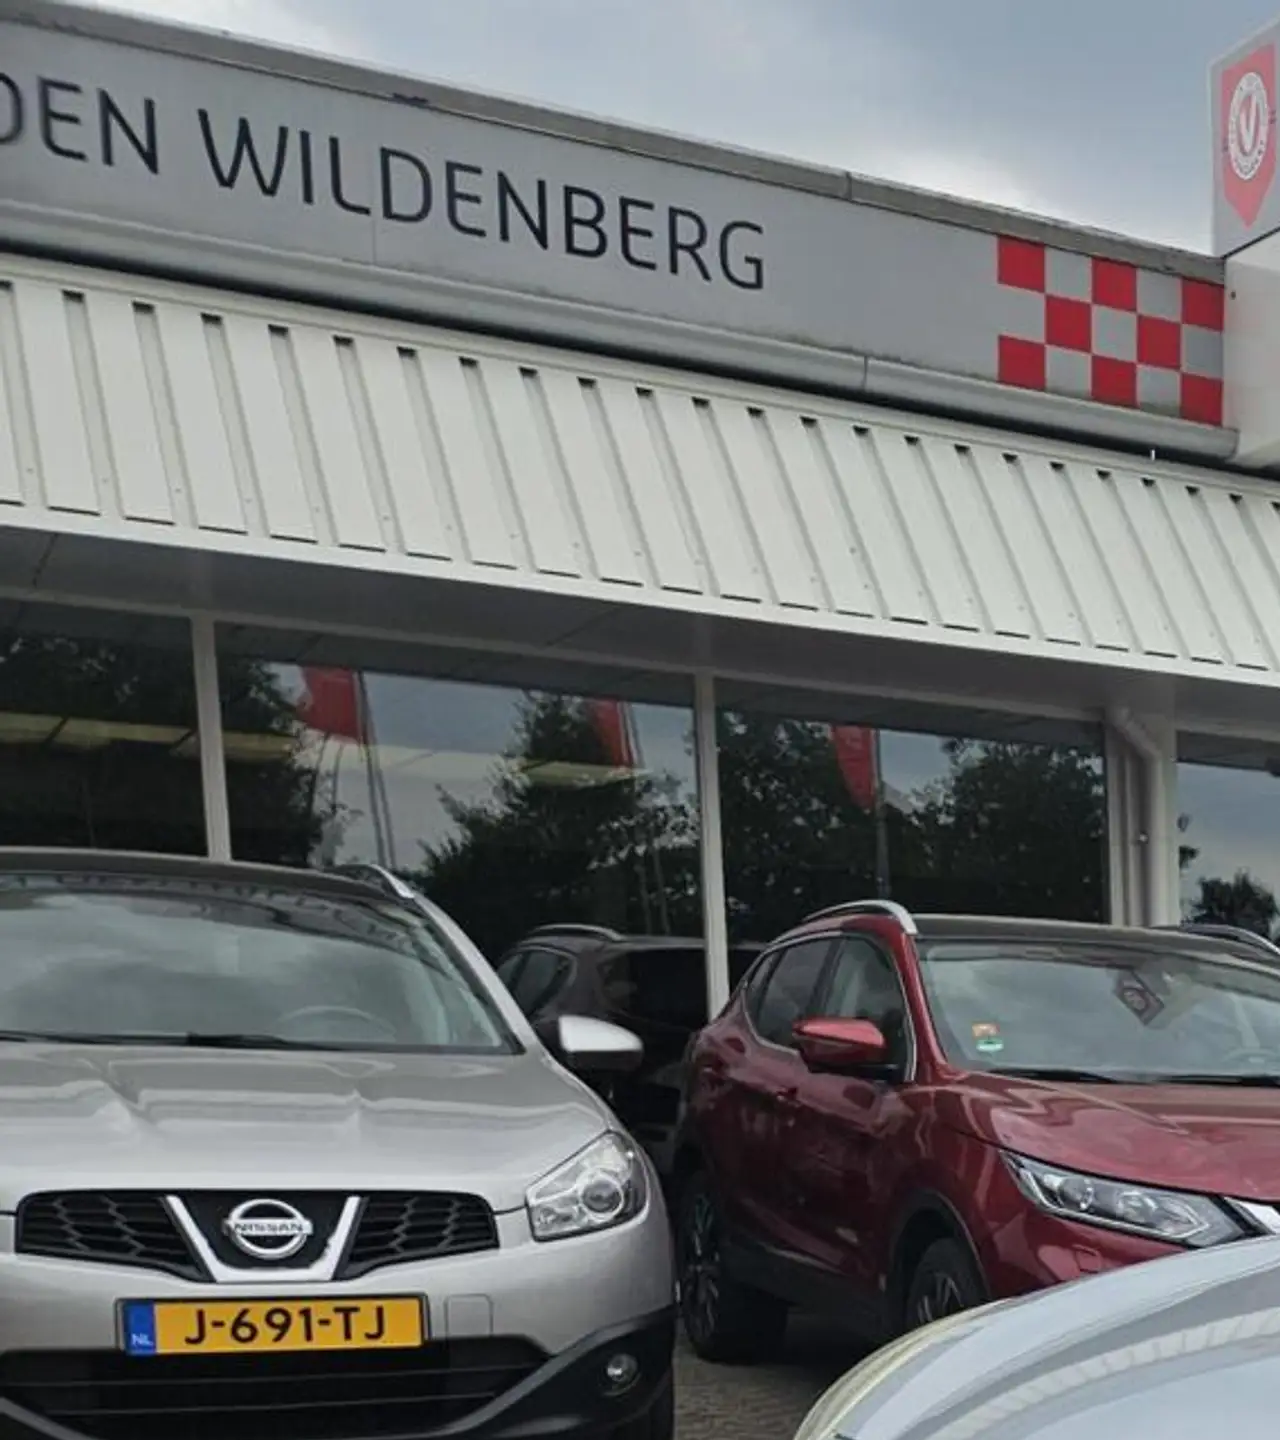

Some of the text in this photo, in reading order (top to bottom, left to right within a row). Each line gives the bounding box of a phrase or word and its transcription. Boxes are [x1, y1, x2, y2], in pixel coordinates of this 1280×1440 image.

[197, 107, 765, 290] WILDENBERG
[132, 1334, 153, 1347] NL
[184, 1306, 385, 1345] J-691-TJ
